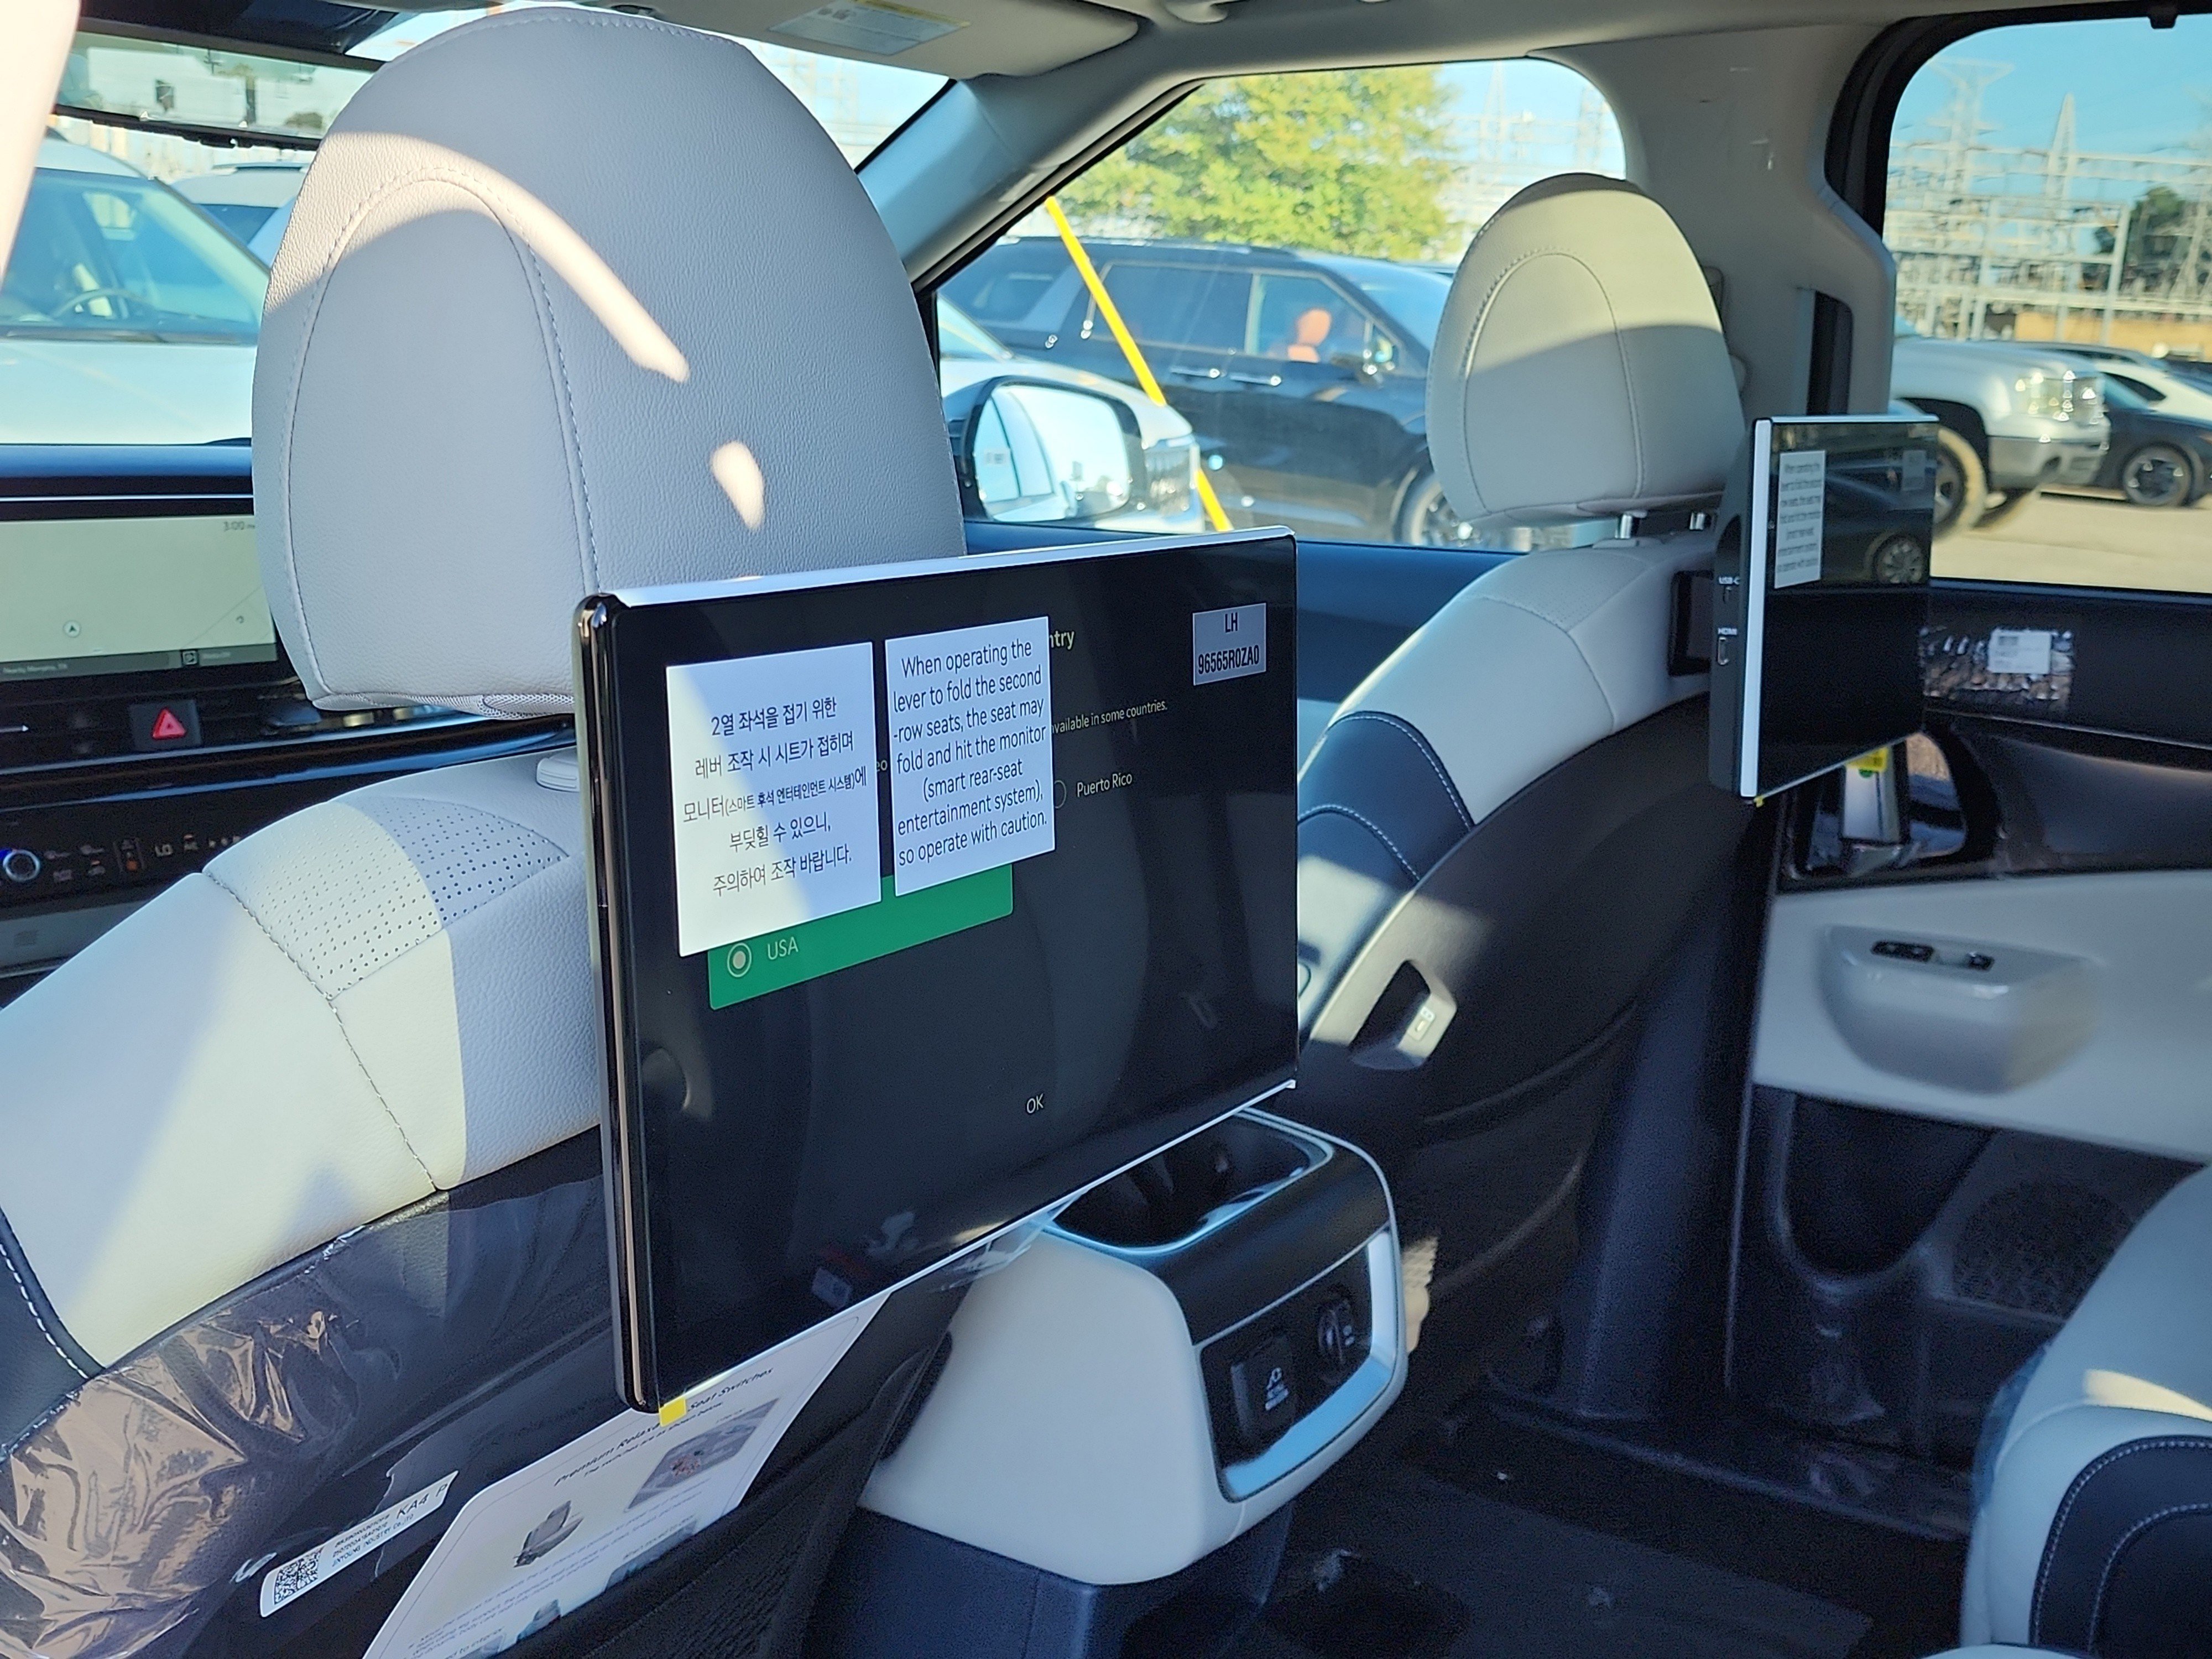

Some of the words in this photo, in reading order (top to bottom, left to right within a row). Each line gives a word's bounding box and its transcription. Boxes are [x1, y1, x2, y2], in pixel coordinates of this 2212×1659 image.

[1049, 630, 1074, 650] ntry
[1224, 612, 1238, 633] LH
[901, 654, 942, 679] When
[946, 644, 1008, 674] operating
[1011, 638, 1032, 659] the
[893, 690, 926, 713] lever
[930, 686, 943, 706] to
[947, 677, 971, 702] fold
[975, 675, 996, 697] the
[999, 664, 1041, 692] second
[711, 713, 734, 737] 2열
[738, 706, 779, 732] 좌석을
[782, 701, 808, 726] 접기
[812, 696, 837, 719] 위한
[893, 723, 923, 743] -row
[926, 714, 963, 737] seats,
[966, 707, 987, 728] the
[991, 701, 1016, 723] seat
[1020, 698, 1044, 718] may
[1091, 712, 1100, 726] in
[1100, 706, 1125, 725] some
[1125, 699, 1168, 719] countries.
[695, 755, 723, 779] 레버
[727, 749, 754, 773] 조작
[758, 745, 771, 768] 시
[775, 737, 813, 764] 시트가
[817, 730, 854, 757] 접히며
[897, 749, 923, 774] fold
[927, 742, 951, 768] and
[956, 738, 973, 761] hit
[975, 735, 996, 757] the
[1000, 725, 1046, 751] monitor
[683, 794, 755, 823] 모니터(스마트
[757, 791, 775, 808] 후석
[776, 779, 827, 805] 엔터테인먼트
[828, 765, 867, 791] 시스템)에
[923, 772, 966, 802] (smart
[969, 758, 1023, 788] rear-seat
[1076, 777, 1110, 798] Puerto
[1112, 772, 1133, 788] Rico
[898, 794, 992, 836] entertainment
[994, 779, 1044, 813] system),
[729, 825, 769, 853] 부딪힐
[773, 821, 787, 843] 수
[790, 811, 831, 839] 있으니,
[899, 848, 914, 867] so
[918, 832, 968, 863] operate
[971, 821, 997, 846] with
[1001, 811, 1047, 837] caution.
[713, 864, 766, 897] 주의하여
[770, 857, 796, 881] 조작
[800, 843, 852, 874] 바랍니다.
[767, 936, 799, 961] USA
[1026, 1094, 1045, 1114] OK
[554, 1447, 614, 1486] Premium
[397, 1493, 429, 1520] KA4
